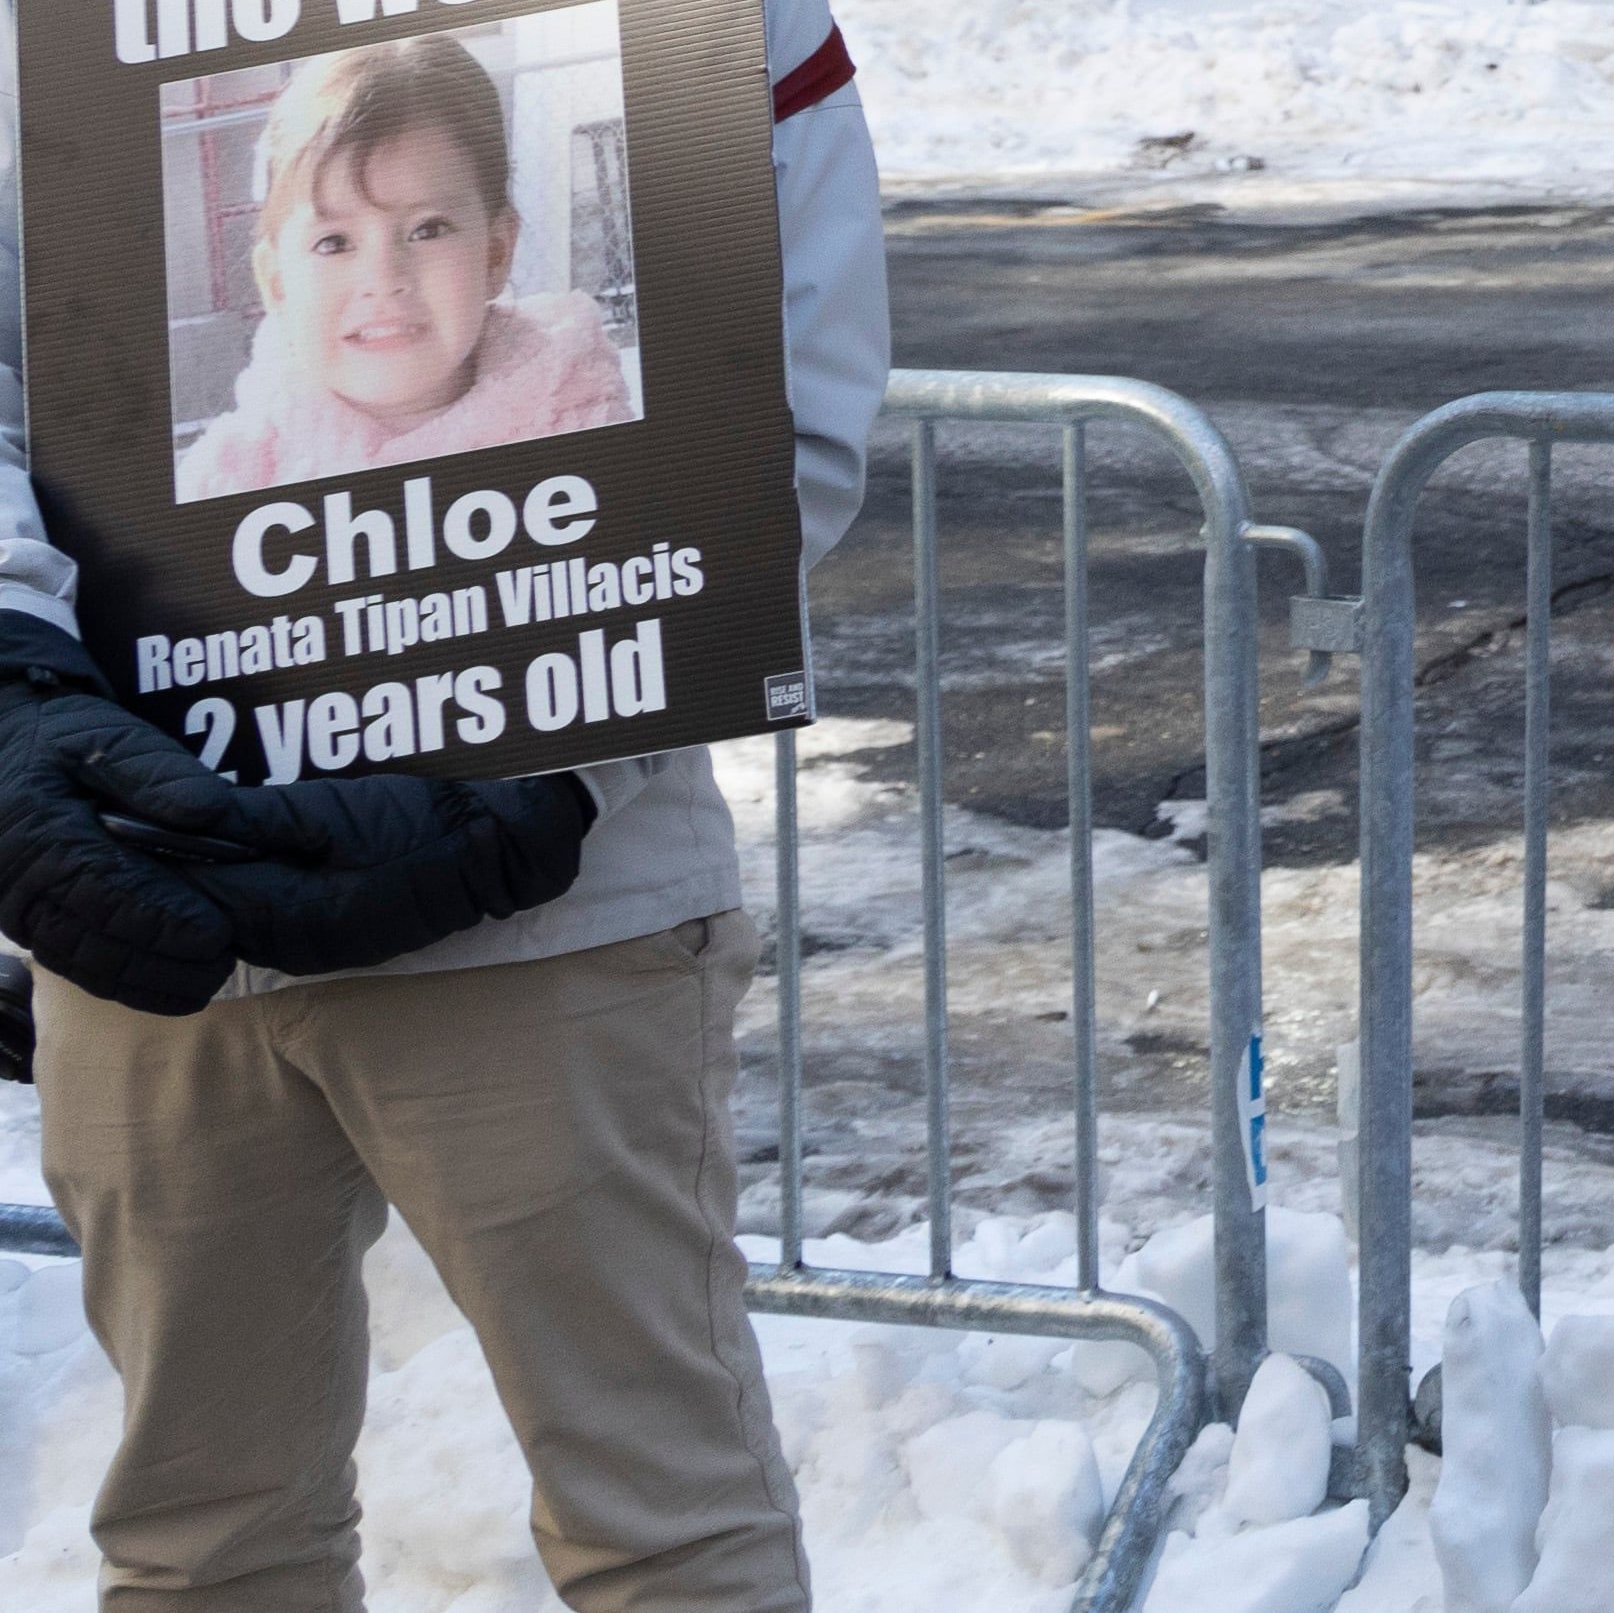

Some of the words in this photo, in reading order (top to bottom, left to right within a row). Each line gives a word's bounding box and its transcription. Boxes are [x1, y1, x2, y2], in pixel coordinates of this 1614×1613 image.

[232, 474, 598, 598] Chloe
[136, 613, 326, 693] Renata
[336, 585, 488, 655] Tipan
[495, 542, 704, 628] Villacis
[185, 697, 238, 785] 2
[254, 664, 507, 787] years
[525, 618, 667, 732] old
[770, 691, 804, 707] RESIST
